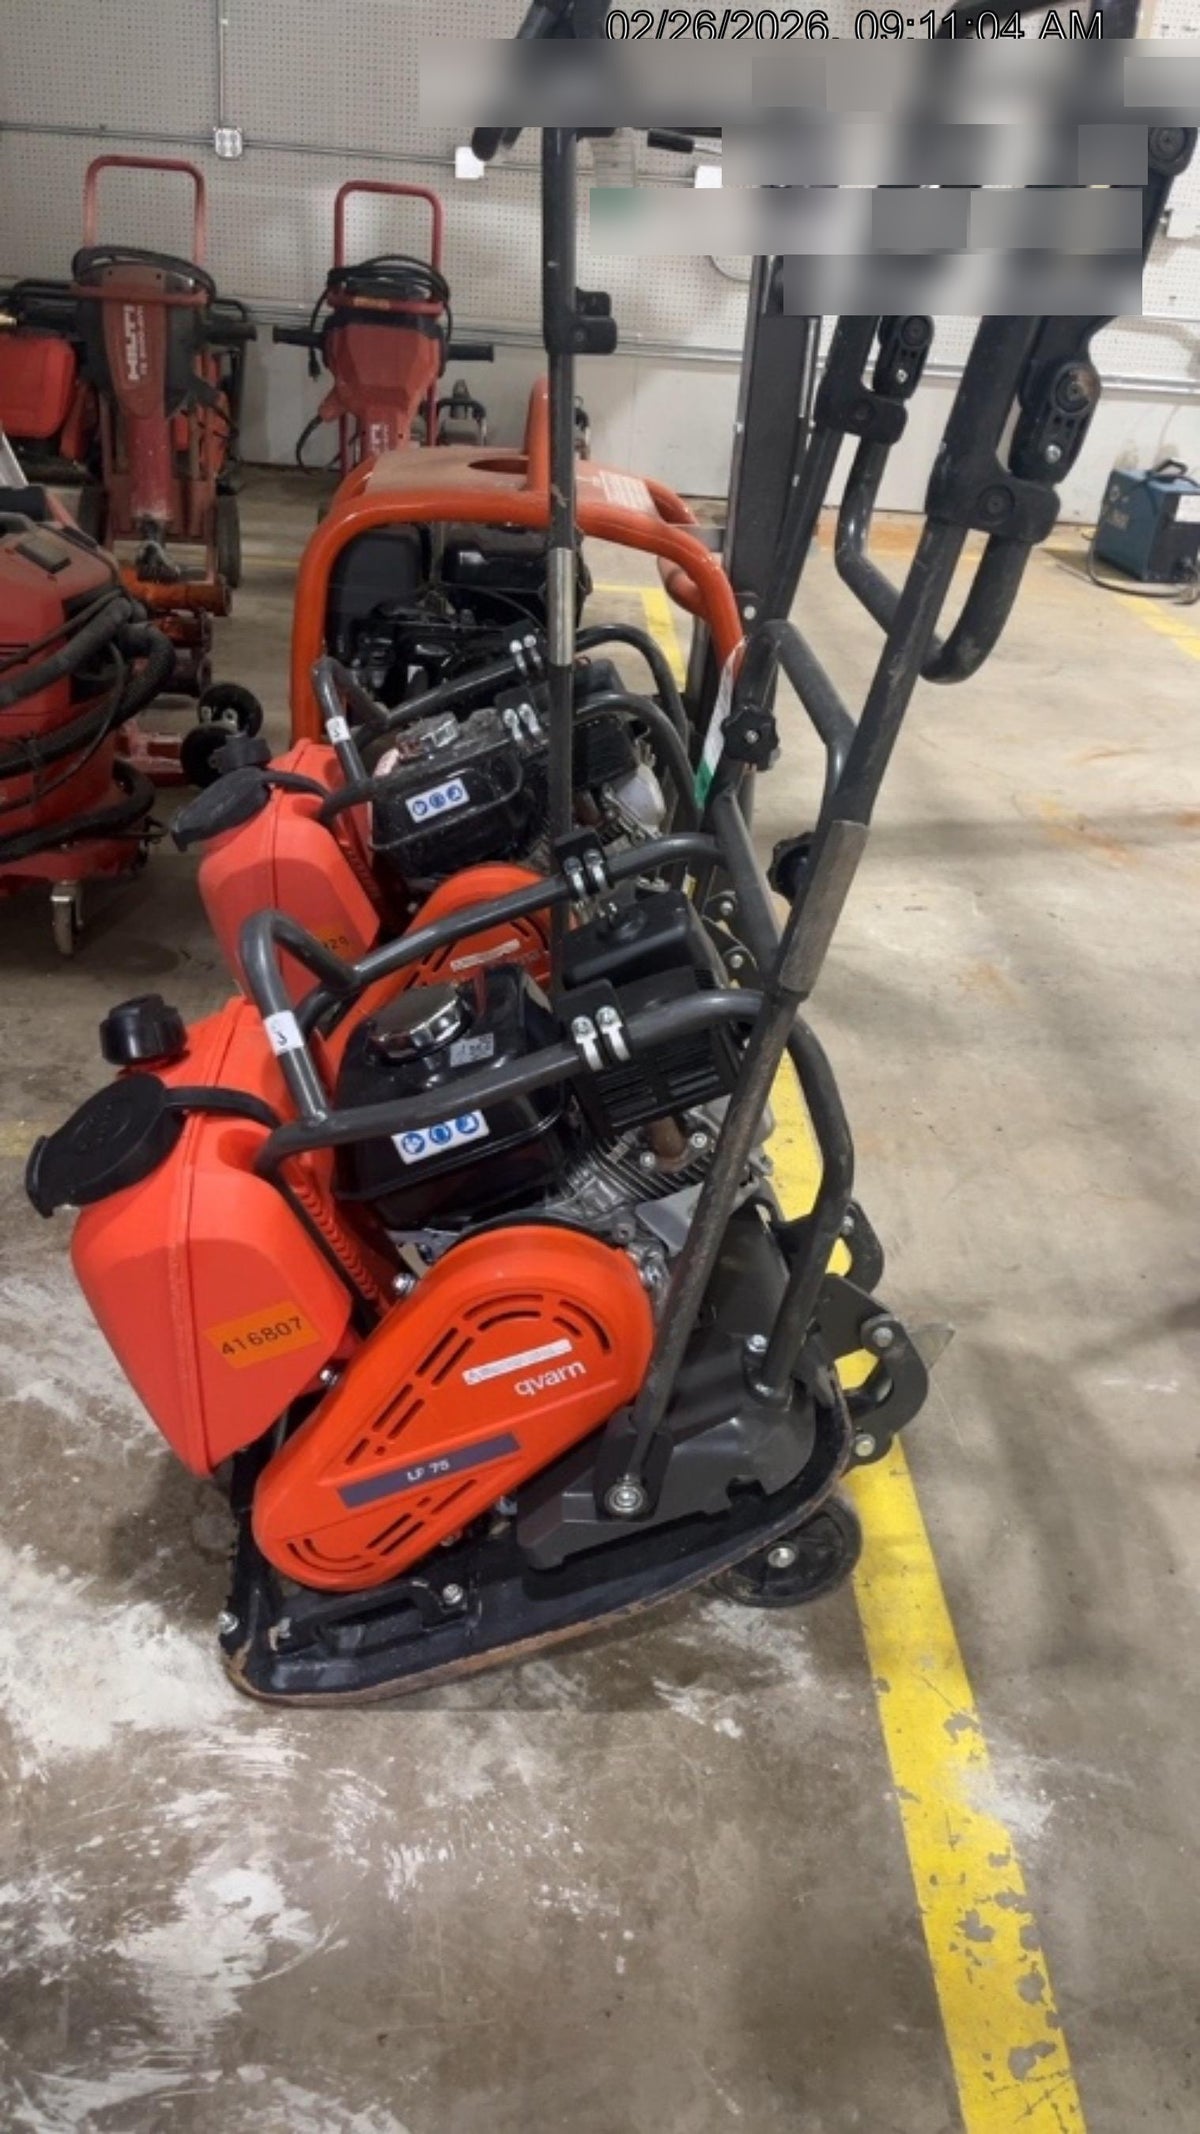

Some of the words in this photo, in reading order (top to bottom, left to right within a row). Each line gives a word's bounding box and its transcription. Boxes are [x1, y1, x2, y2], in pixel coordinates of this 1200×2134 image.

[123, 304, 139, 380] HILTI
[222, 1316, 301, 1354] 416807
[513, 1361, 586, 1396] qvarn
[407, 1467, 425, 1482] LF
[429, 1459, 450, 1474] 75
